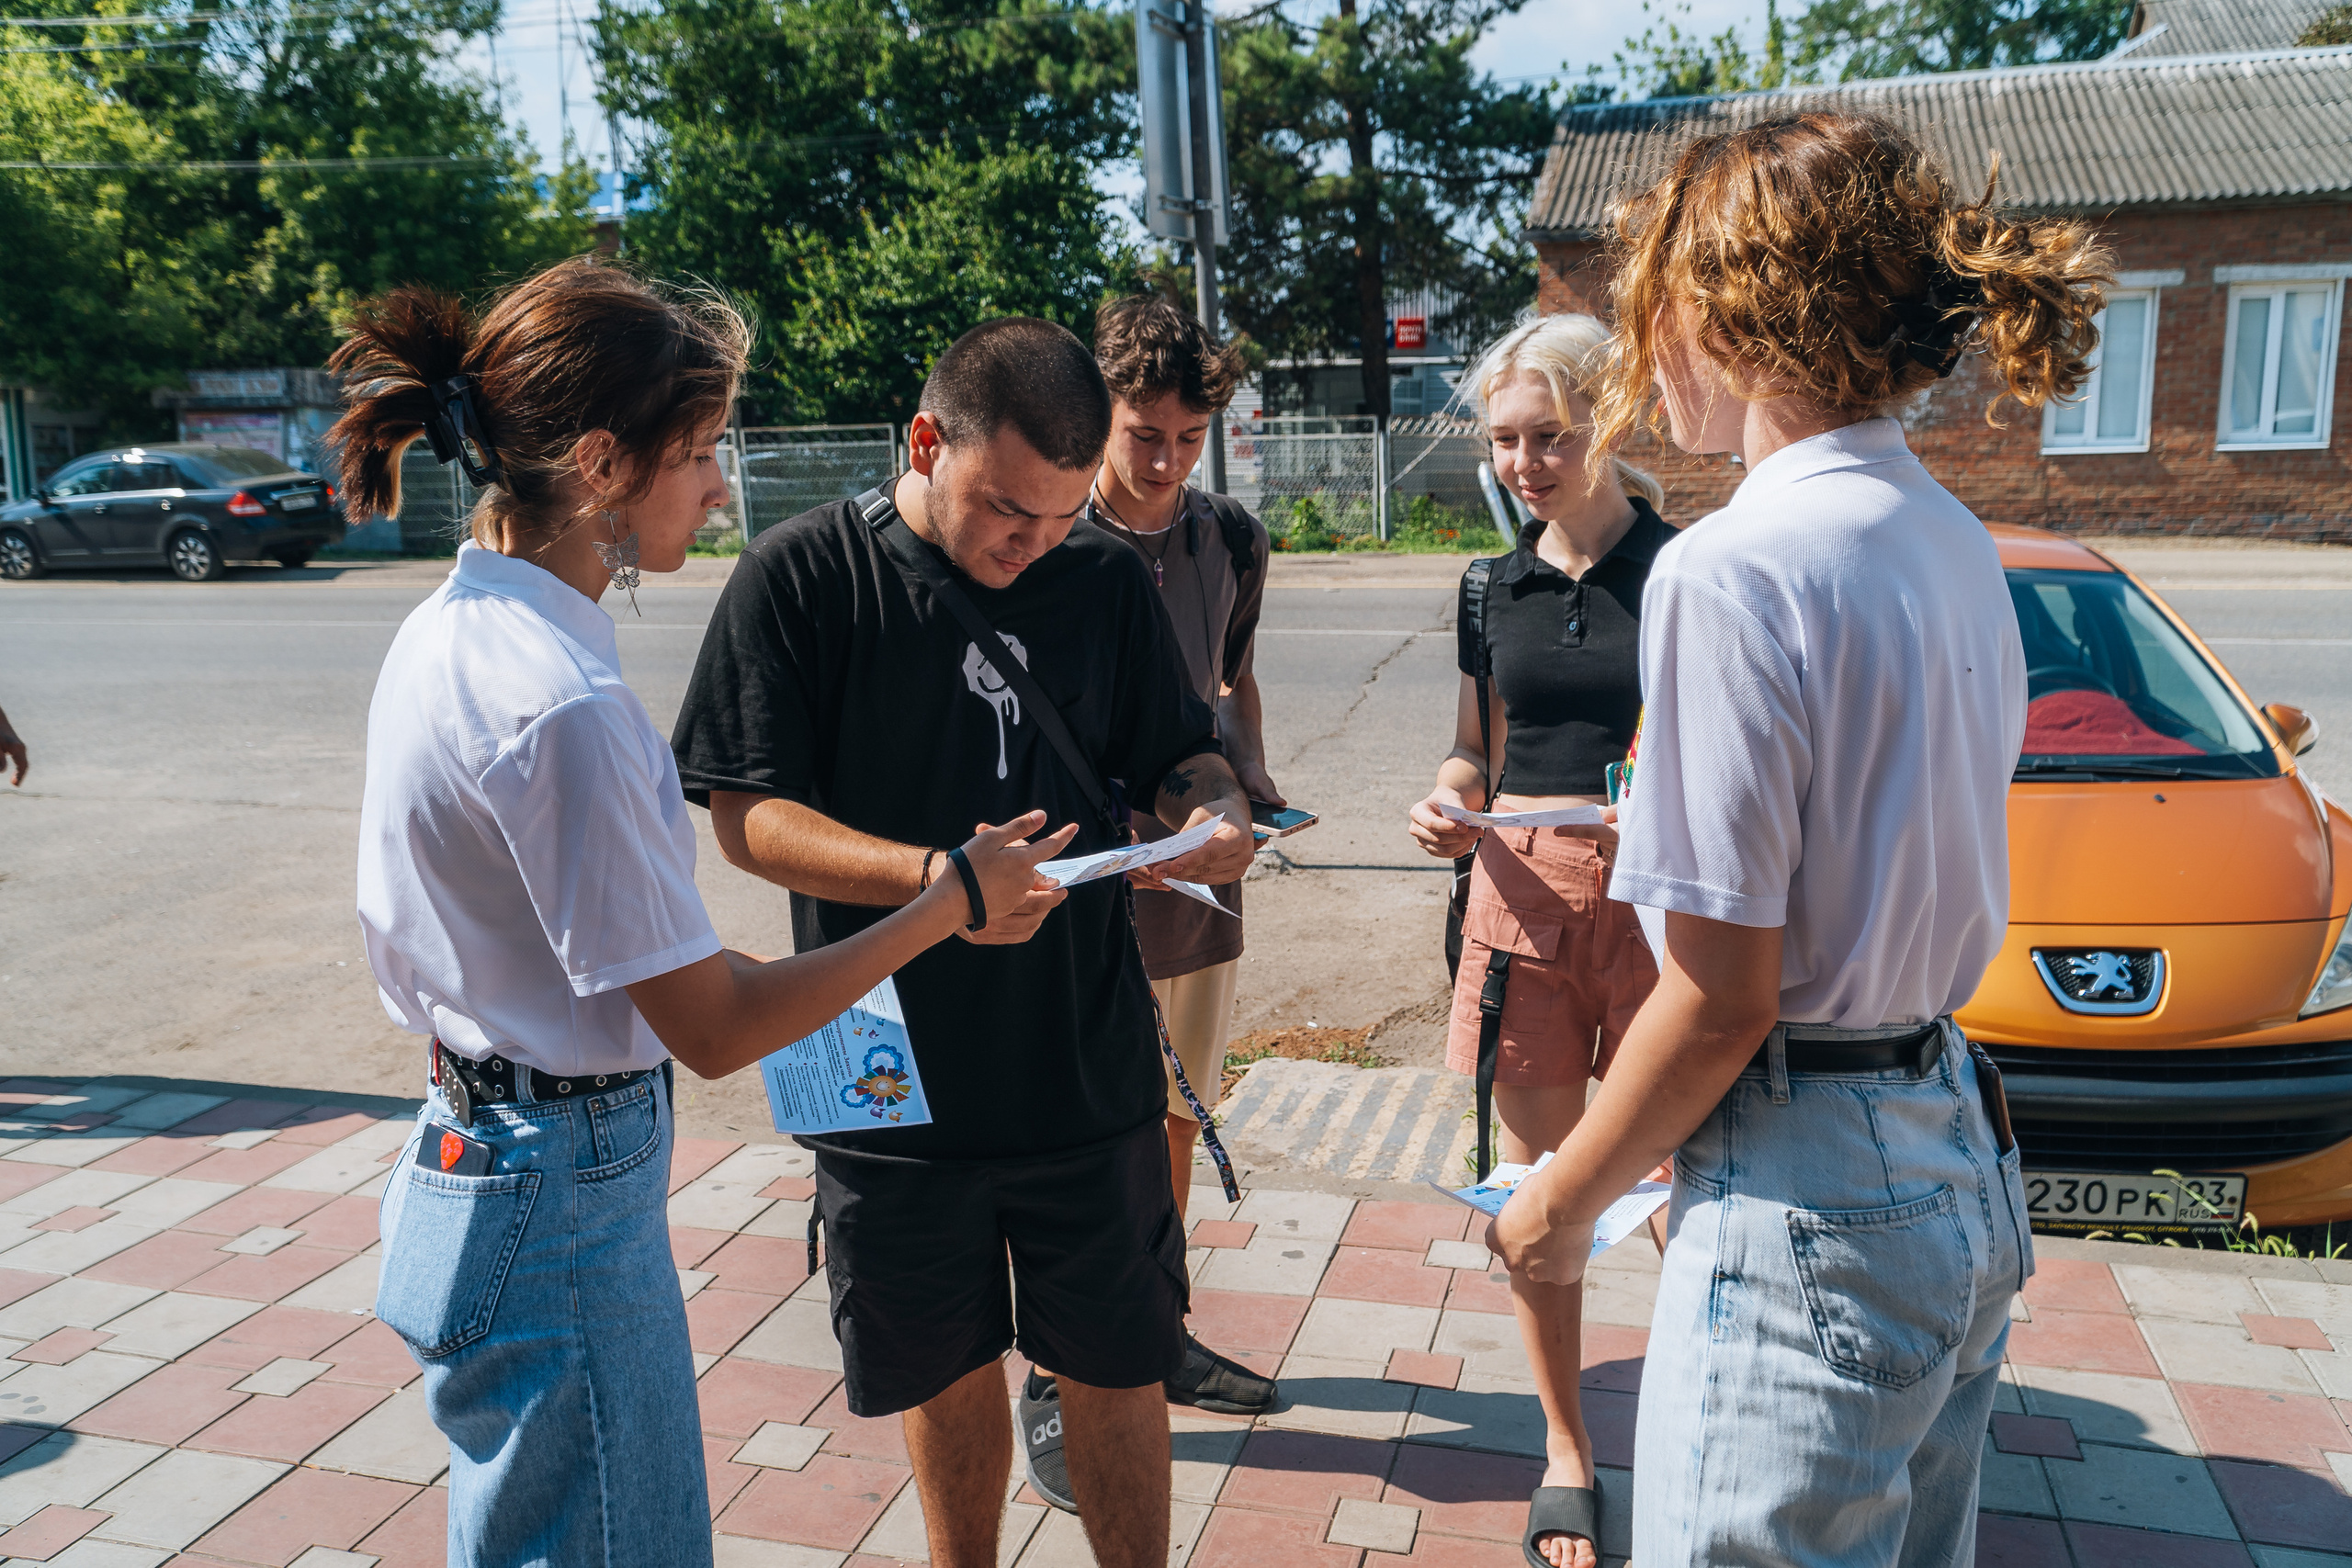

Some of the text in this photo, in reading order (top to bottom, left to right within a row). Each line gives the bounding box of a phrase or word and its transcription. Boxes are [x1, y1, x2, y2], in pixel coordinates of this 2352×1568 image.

[1466, 558, 1492, 634] WHITE
[843, 1055, 854, 1077] Закона
[2186, 1181, 2227, 1207] 93
[2178, 1208, 2211, 1219] RUS
